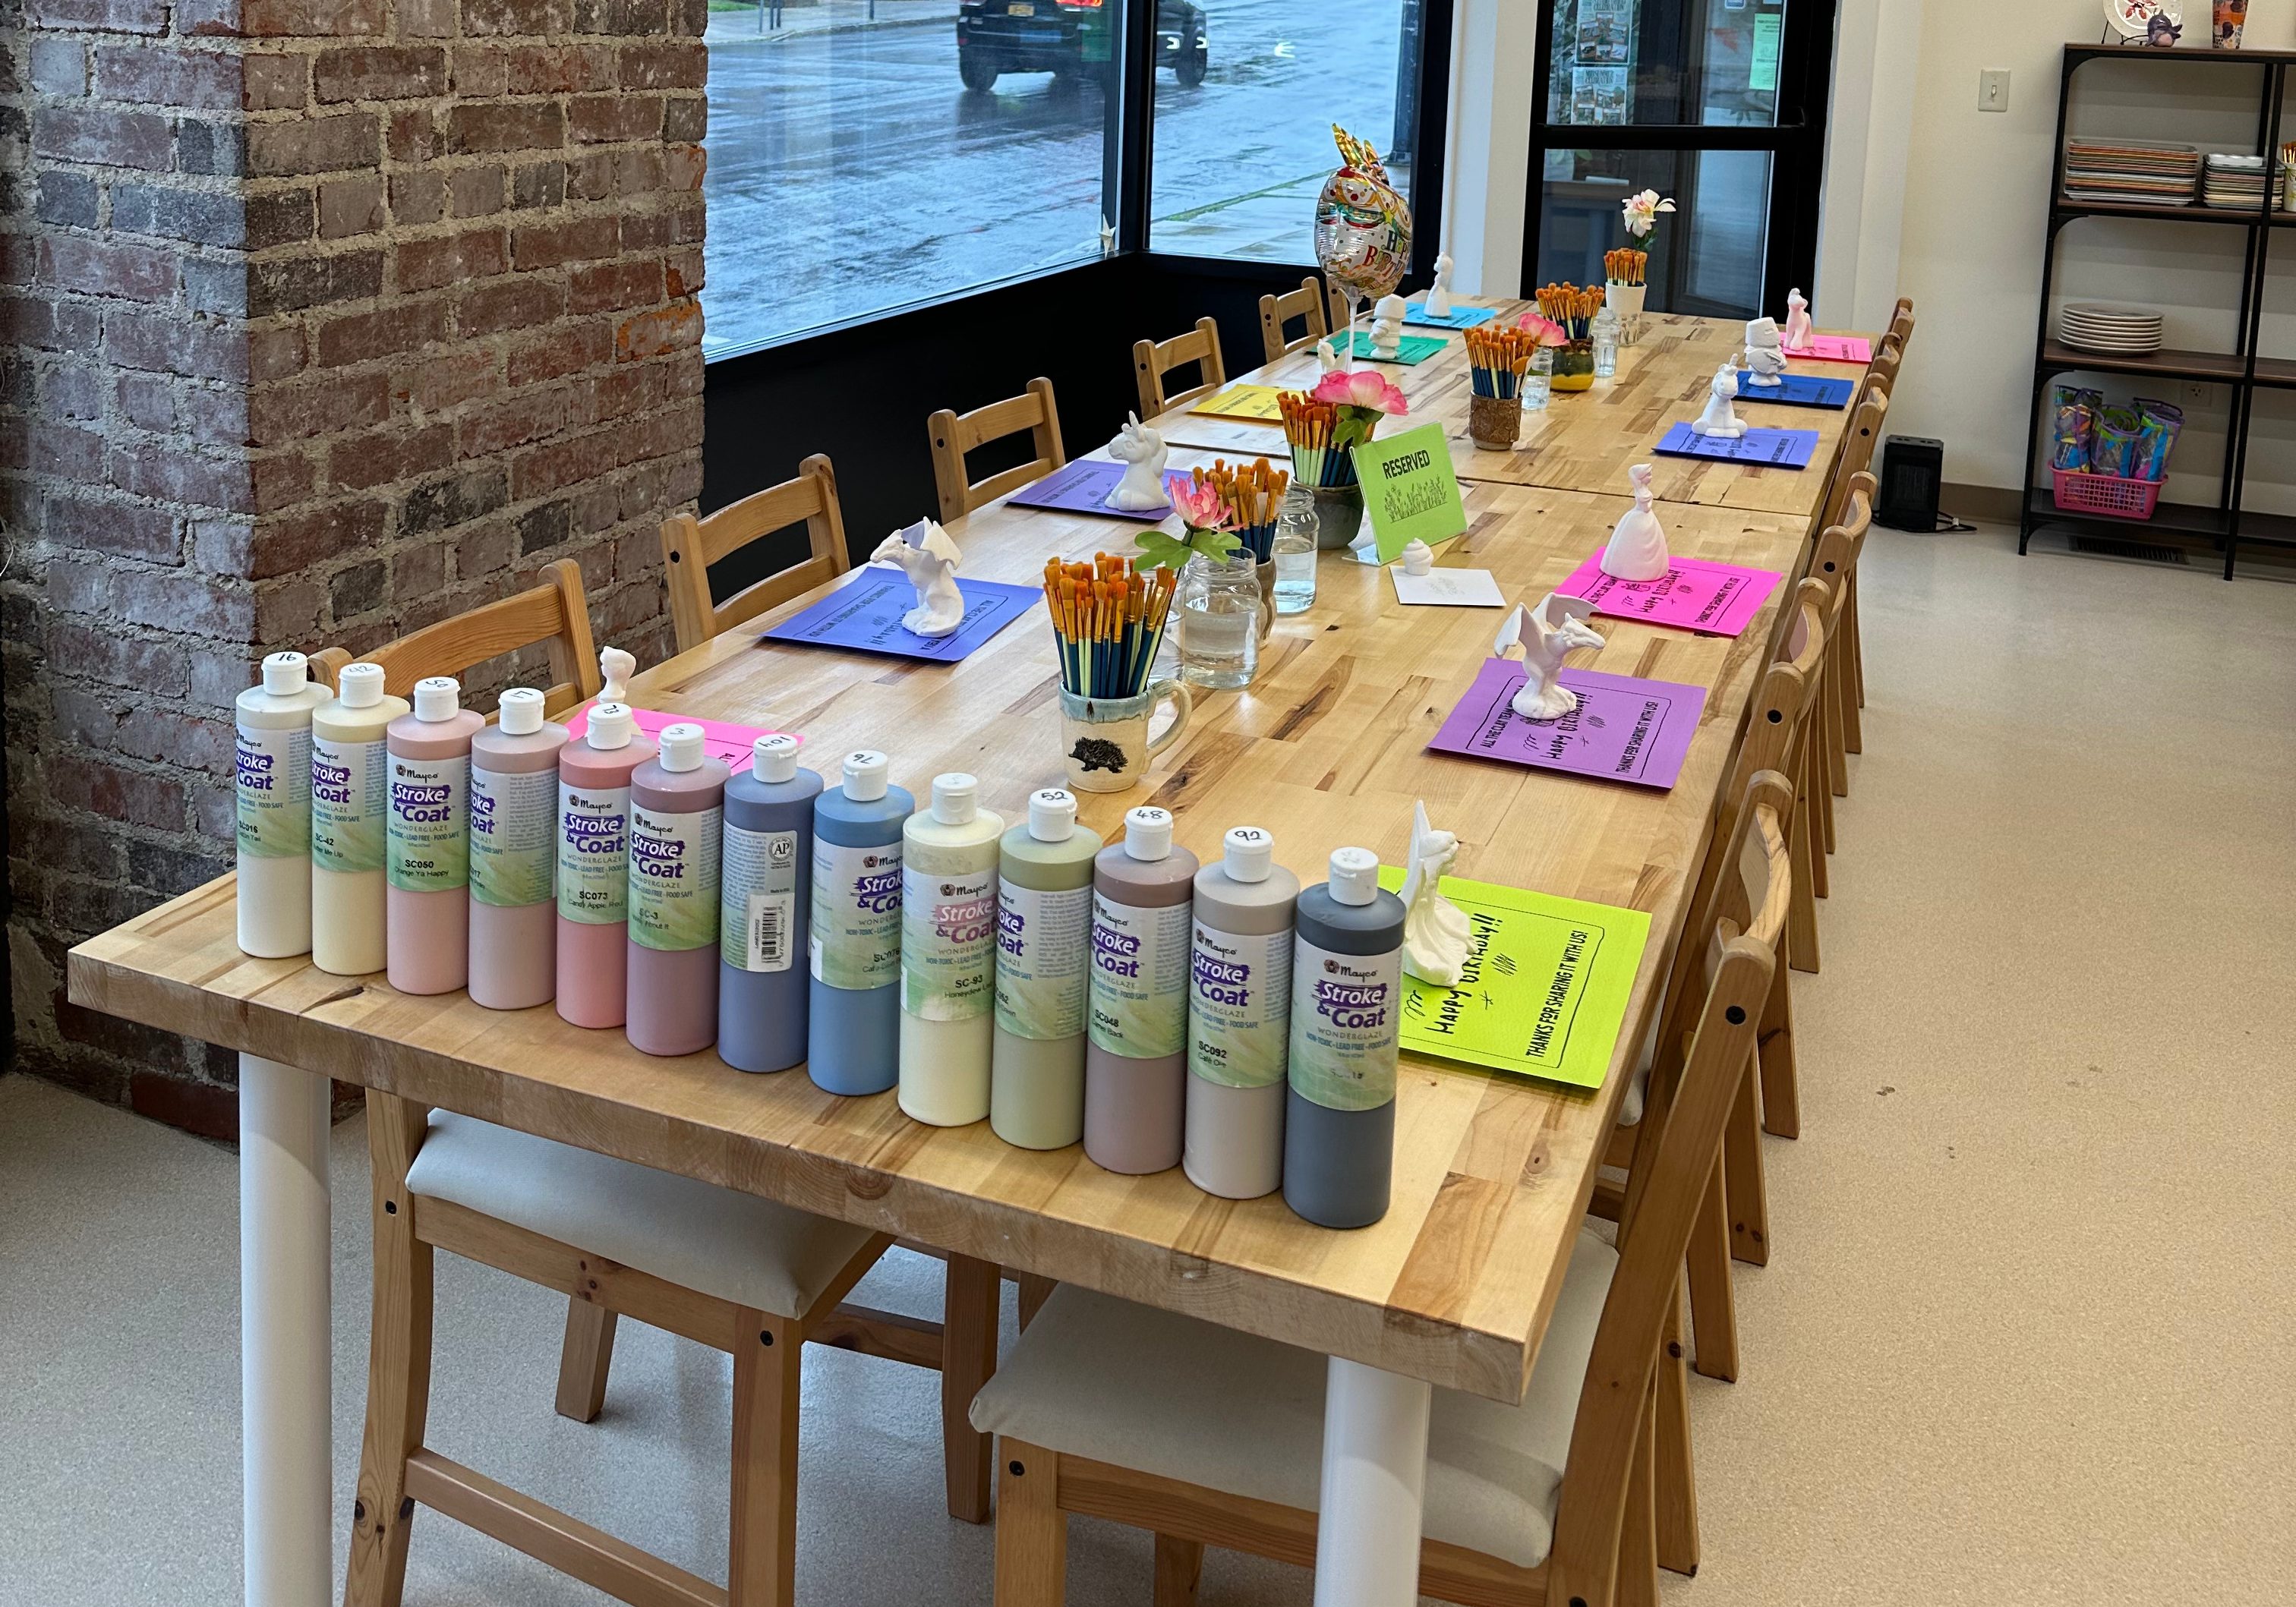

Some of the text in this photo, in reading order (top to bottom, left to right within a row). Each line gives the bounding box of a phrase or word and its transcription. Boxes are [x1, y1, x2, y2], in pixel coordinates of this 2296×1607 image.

[1382, 449, 1430, 479] RESERVED
[278, 653, 297, 663] 16
[347, 664, 375, 675] 42
[757, 736, 791, 748] 104
[1539, 734, 1573, 760] HAPPY
[237, 752, 268, 770] troke
[316, 747, 339, 763] Mayco
[238, 769, 274, 790] Coat
[406, 769, 438, 783] Mayco
[314, 781, 351, 803] Coat
[395, 784, 445, 802] Stroke
[1041, 790, 1068, 801] 52
[402, 805, 451, 823] Coat
[580, 798, 612, 814] Mayco
[1136, 810, 1163, 819] 48
[471, 815, 495, 834] oat
[569, 815, 620, 833] Stroke
[643, 818, 673, 837] Mayco
[315, 833, 334, 846] SC-42
[576, 836, 624, 853] Coat
[1235, 830, 1263, 841] 92
[632, 833, 679, 858] Stroke
[774, 843, 790, 855] AP
[405, 859, 434, 868] SC050
[638, 857, 686, 878] Coat
[862, 870, 903, 893] Strok
[956, 884, 988, 897] Mayco
[579, 890, 608, 900] SC073
[857, 896, 871, 909] &
[940, 900, 993, 922] Stroke
[1101, 906, 1128, 929] Mayco
[935, 917, 997, 944] & Coat
[997, 933, 1024, 956] oat
[1204, 937, 1237, 958] Mayco
[1096, 947, 1140, 978] Coat
[1194, 951, 1244, 983] Stroke
[955, 974, 983, 988] SC-93
[1340, 966, 1377, 982] Mayco
[1200, 978, 1250, 1007] Coat
[1321, 983, 1382, 1005] Stroke
[1525, 930, 1589, 1058] THANKS FOR SHARING IT WITH US!
[1095, 1009, 1119, 1027] SC048
[1317, 1000, 1386, 1029] & Coat
[1424, 989, 1472, 1035] HAPPY
[1317, 1026, 1383, 1040] WONDERGLAZE
[1199, 1040, 1227, 1058] SC092
